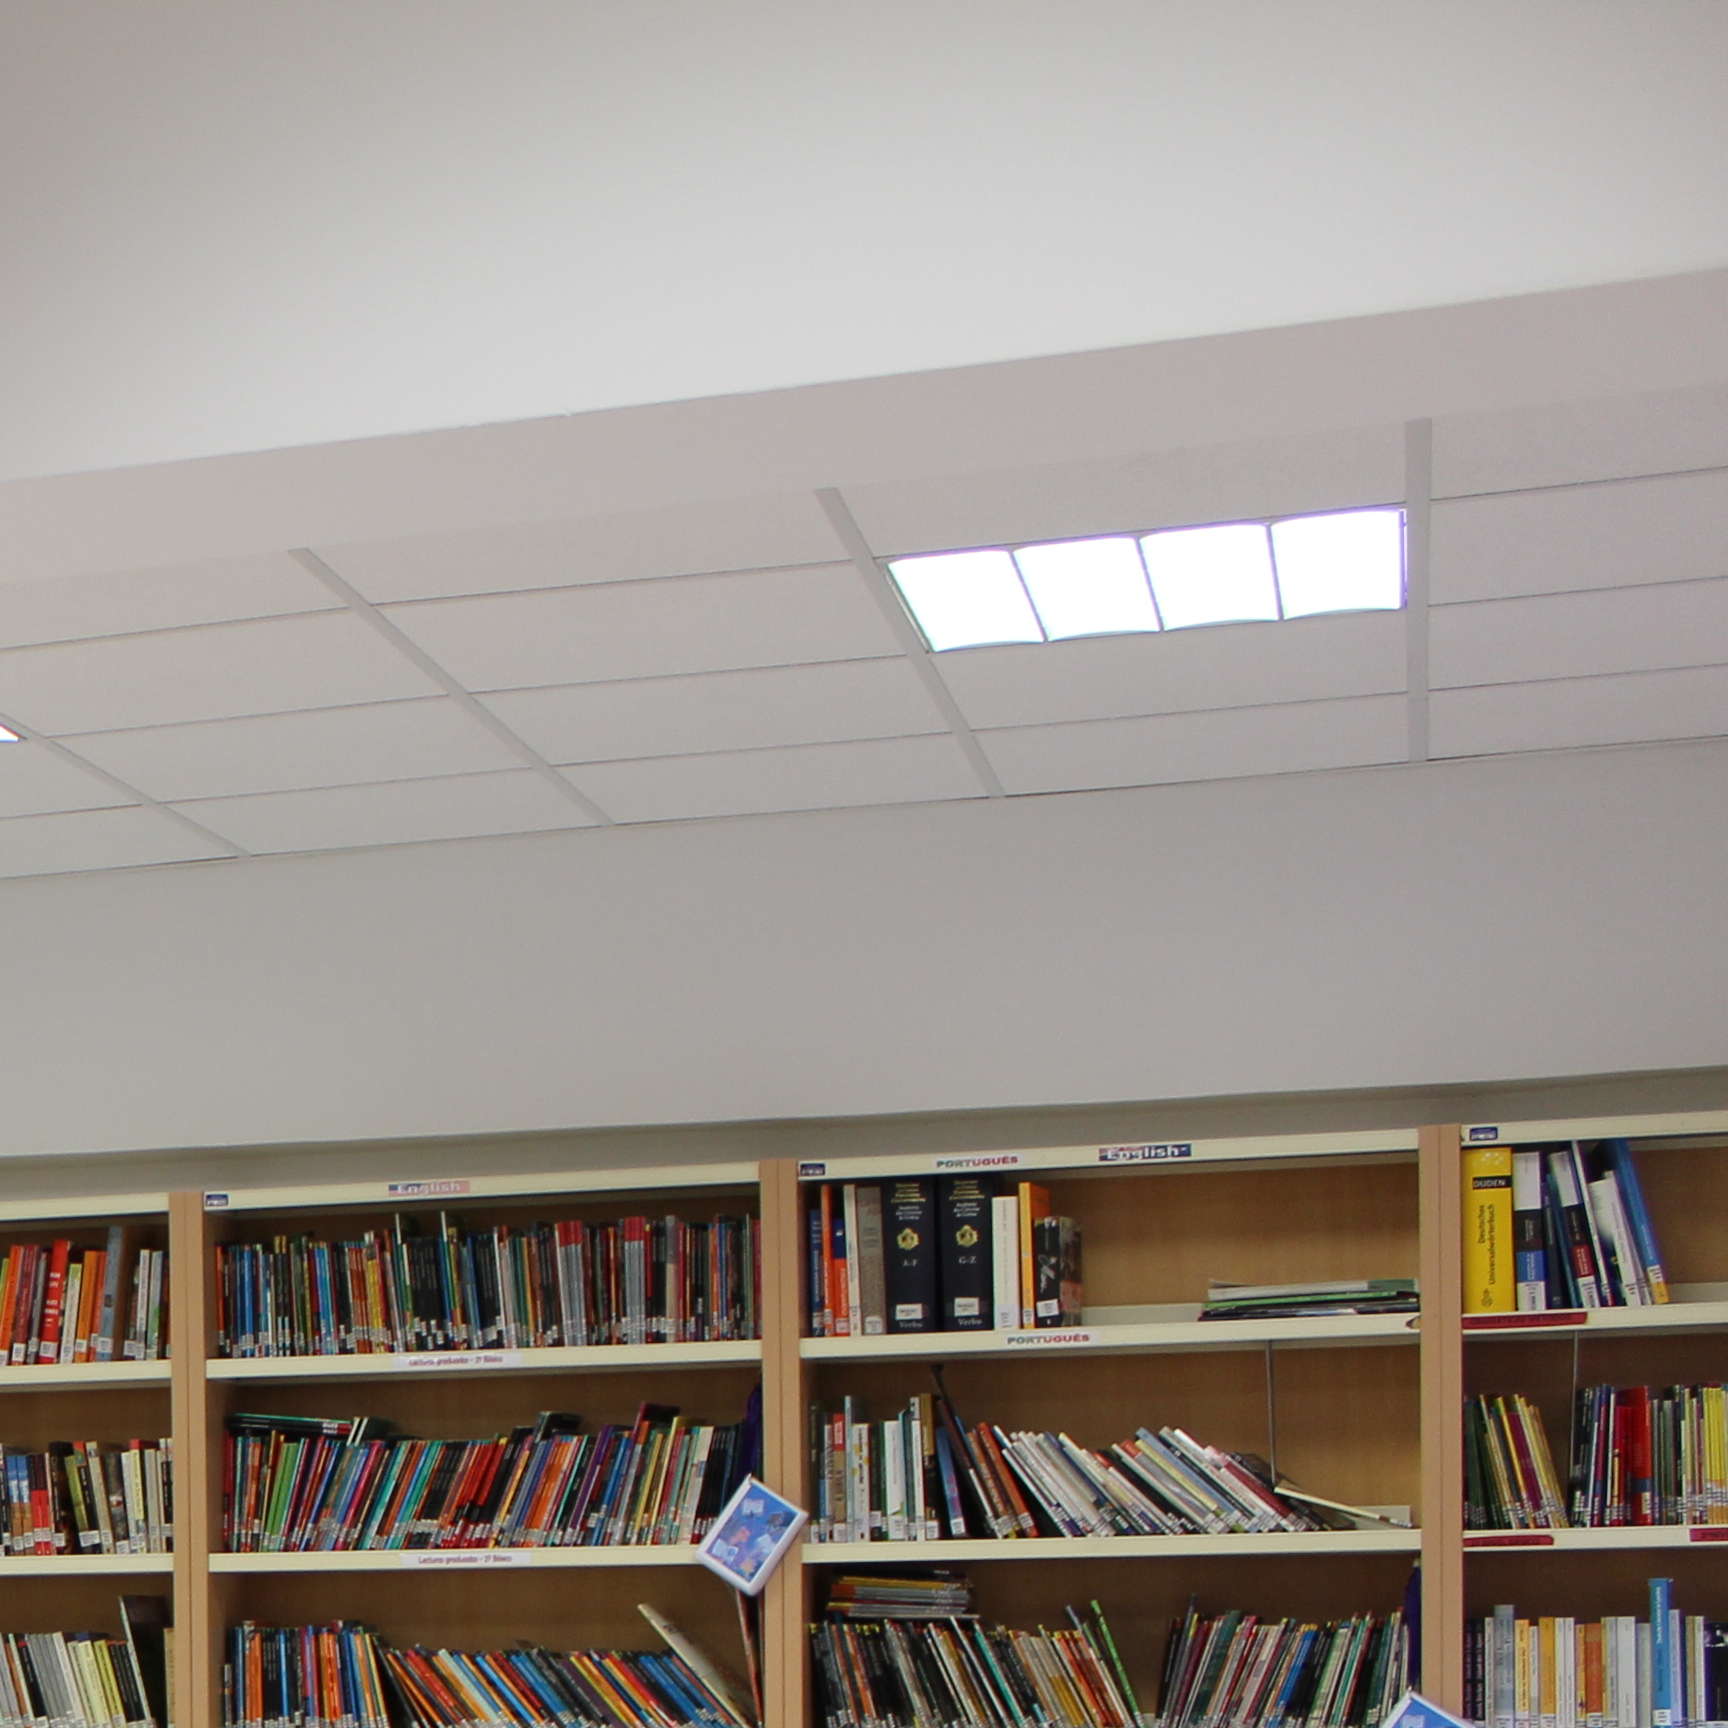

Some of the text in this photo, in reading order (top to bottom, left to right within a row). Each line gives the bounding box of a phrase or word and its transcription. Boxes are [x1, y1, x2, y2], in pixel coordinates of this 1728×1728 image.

[1106, 1144, 1179, 1160] English
[936, 1155, 1018, 1168] PORTUGUÊS
[396, 1181, 460, 1195] English
[1473, 1179, 1506, 1188] DUDEN
[1007, 1333, 1090, 1345] PORTUGUÊS
